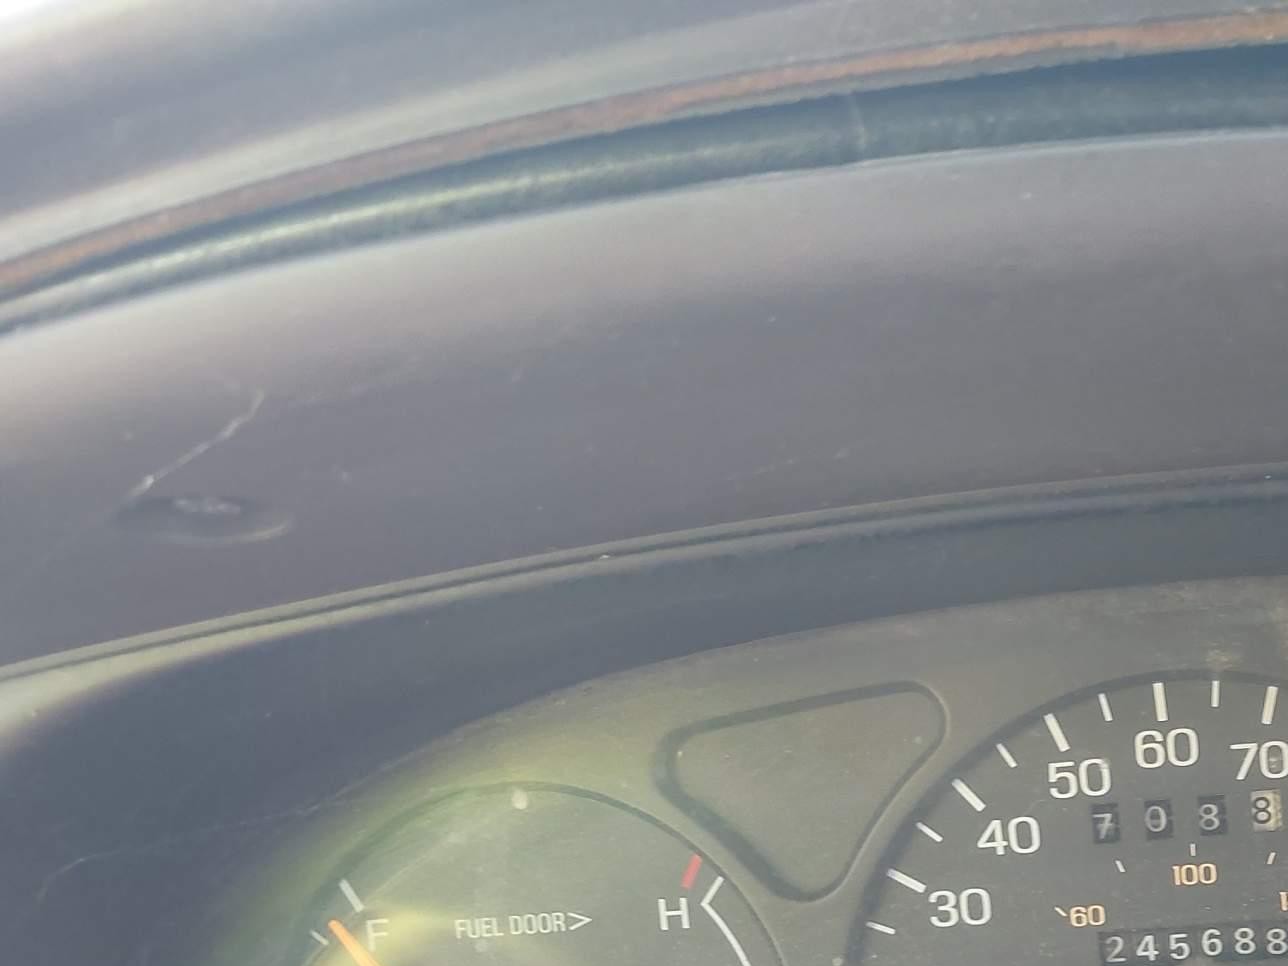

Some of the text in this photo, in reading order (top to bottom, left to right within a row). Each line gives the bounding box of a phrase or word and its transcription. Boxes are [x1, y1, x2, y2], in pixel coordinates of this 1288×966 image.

[1134, 727, 1200, 768] 60
[1047, 758, 1112, 800] 50
[976, 816, 1042, 855] 40
[1171, 863, 1218, 887] 100
[656, 896, 692, 932] H
[928, 887, 993, 927] 30
[1069, 904, 1106, 927] 60
[365, 918, 391, 952] F
[455, 918, 504, 940] FUEL
